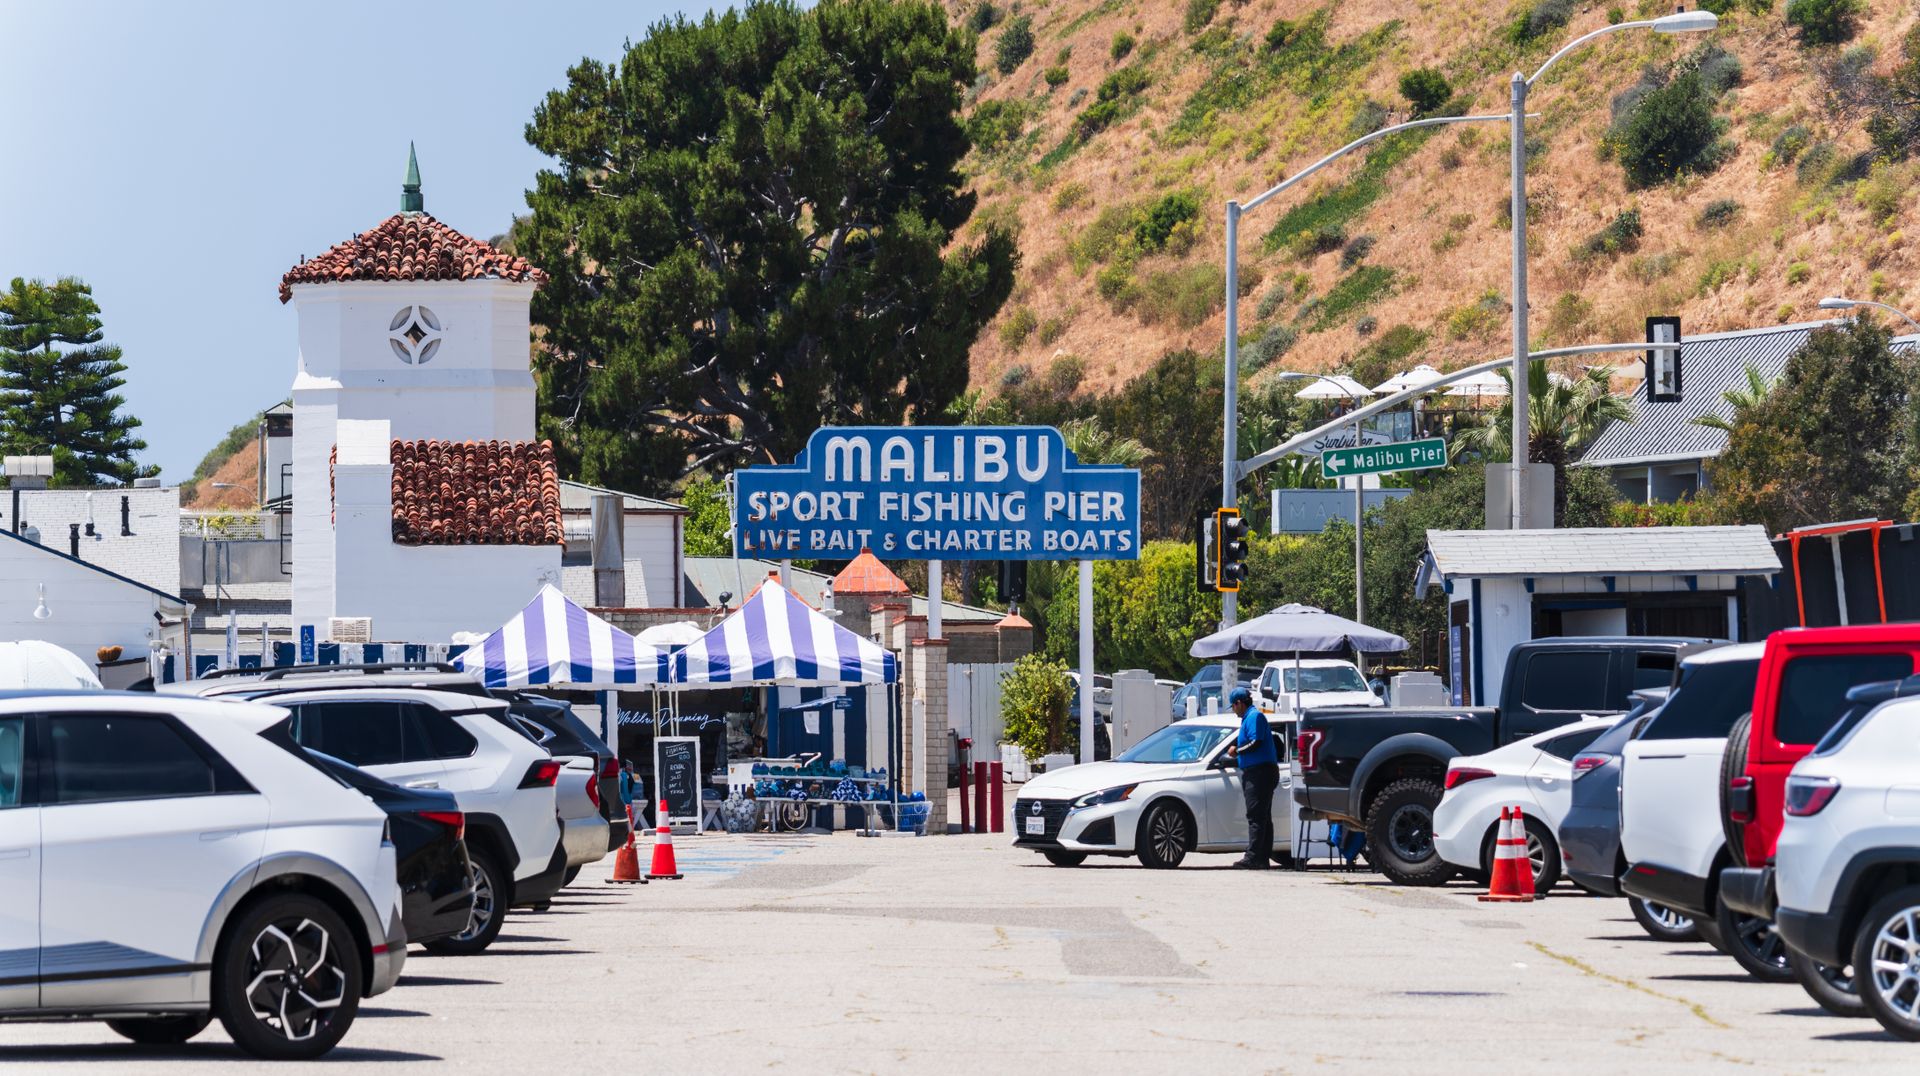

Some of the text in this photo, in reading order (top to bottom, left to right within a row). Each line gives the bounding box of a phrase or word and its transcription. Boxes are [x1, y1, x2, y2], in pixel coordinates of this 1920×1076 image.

[825, 435, 1050, 482] MALIBU
[1353, 446, 1443, 469] Malibu Pier
[748, 491, 1126, 522] SPORT FISHING PIER
[744, 529, 1132, 551] LIVE BAIT & CHARTER BOATS
[617, 707, 655, 725] Malibu
